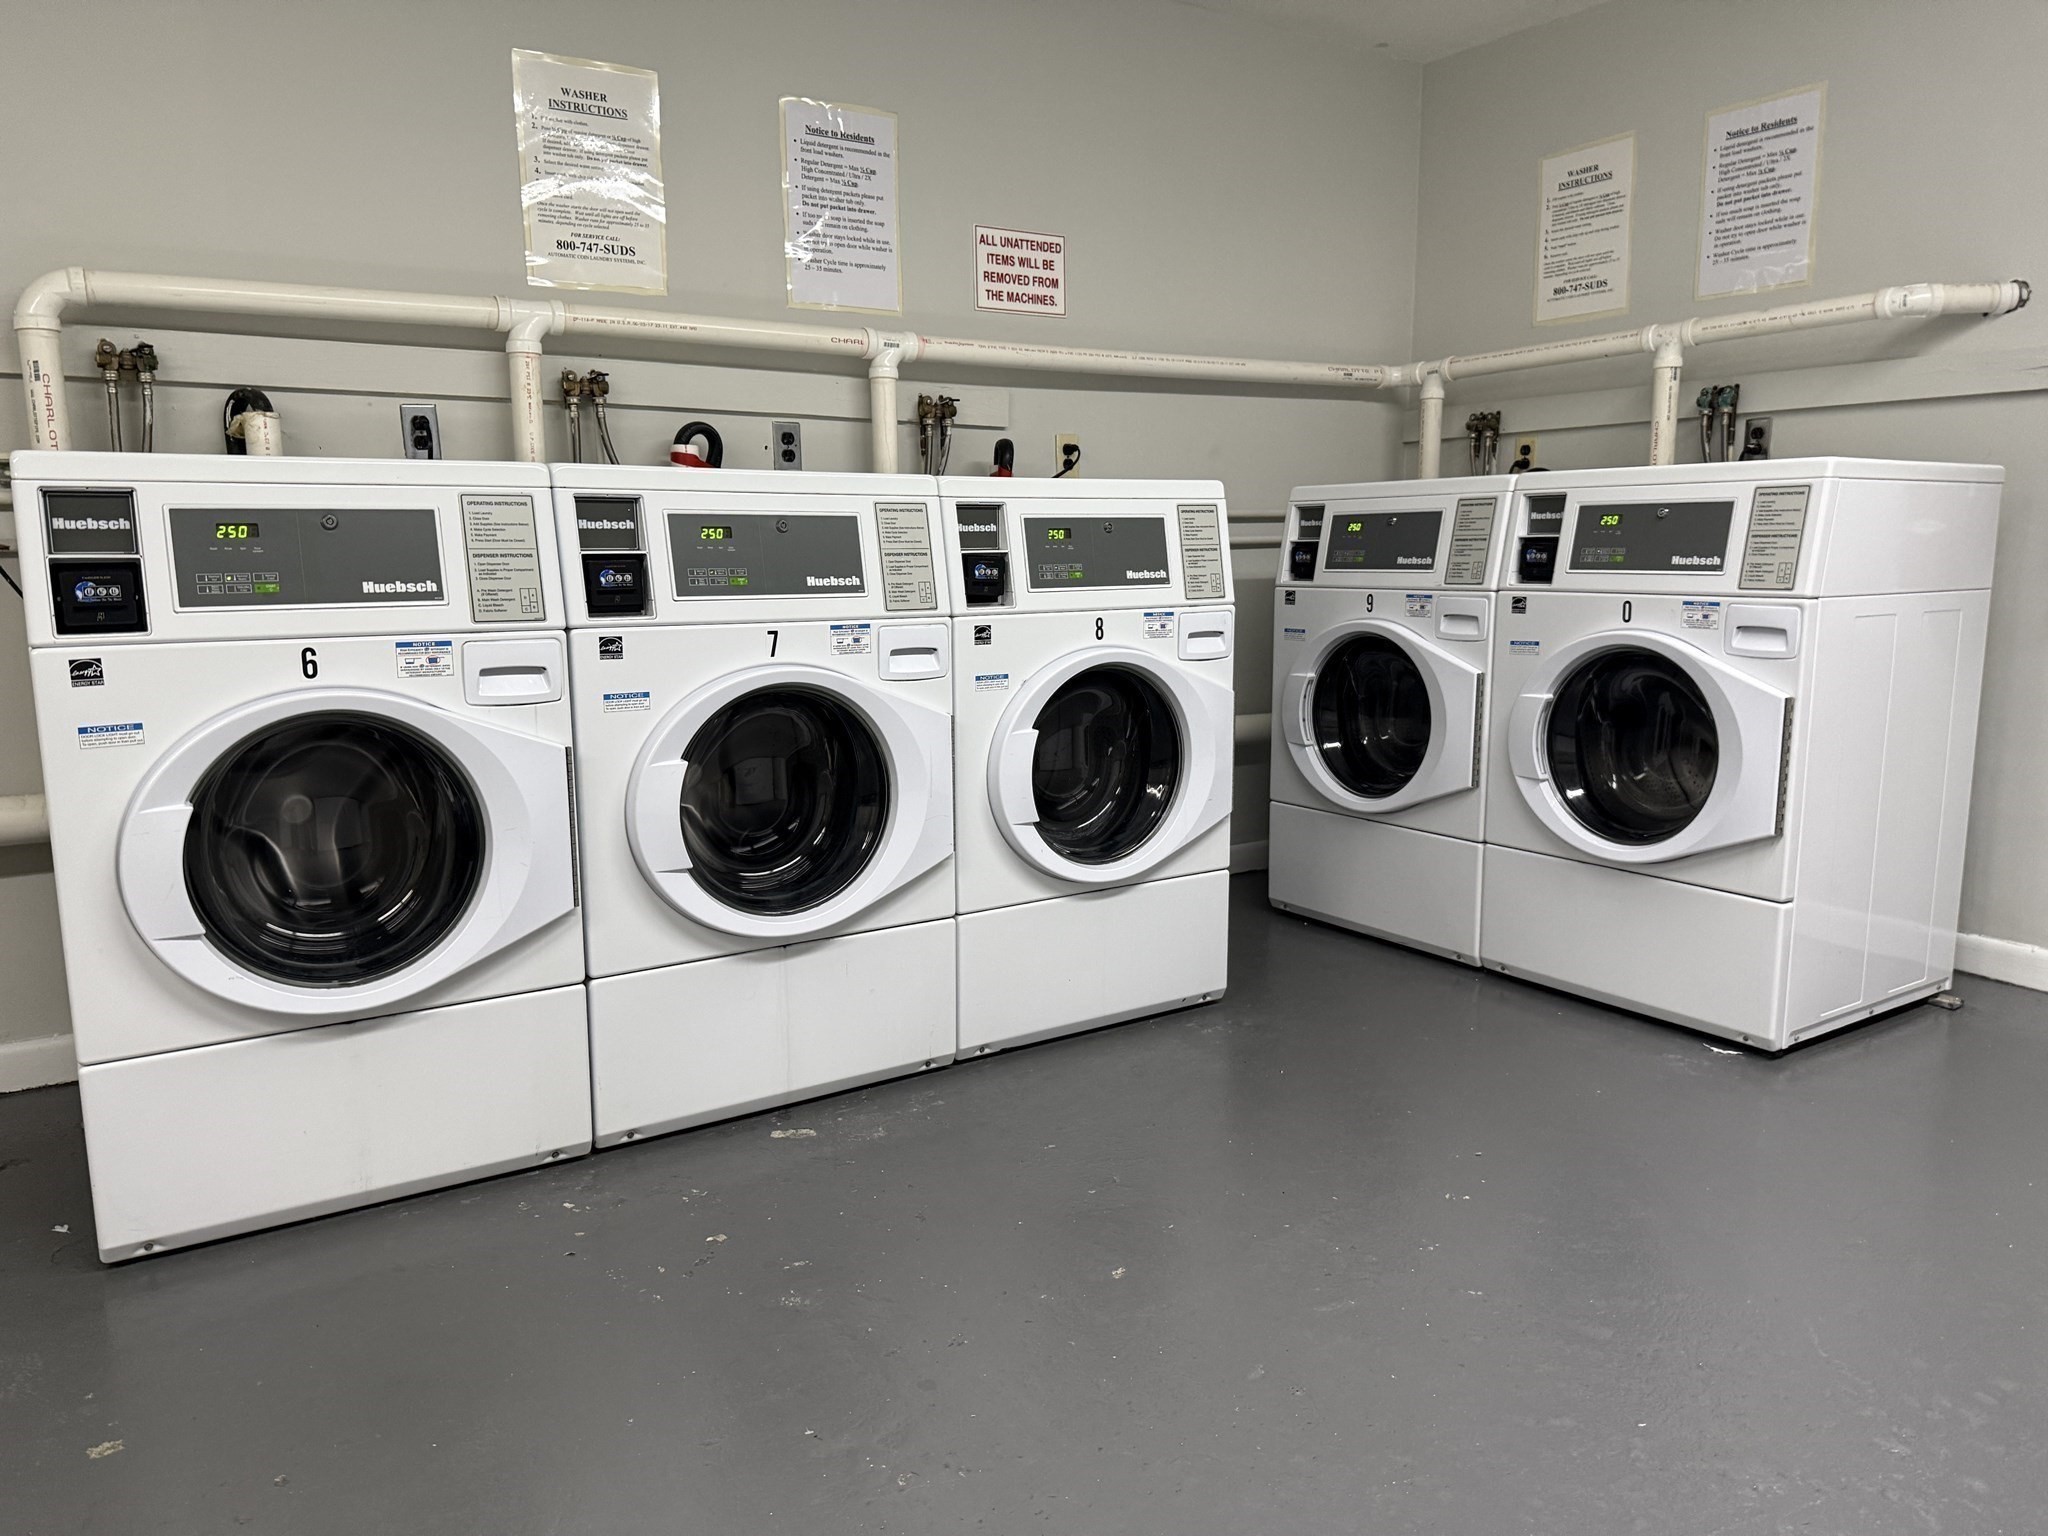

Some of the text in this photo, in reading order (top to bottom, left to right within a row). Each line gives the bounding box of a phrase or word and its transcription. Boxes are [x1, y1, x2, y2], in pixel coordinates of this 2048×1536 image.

[561, 87, 607, 103] WASHER
[548, 98, 628, 120] INSTRUCTIONS
[1725, 113, 1798, 141] Notice to Residents
[805, 124, 875, 145] Notice to Residents
[800, 138, 816, 148] Liquid
[817, 141, 839, 151] detergent
[845, 145, 876, 156] recommended
[533, 155, 540, 163] 3.
[801, 157, 819, 167] Regular
[821, 160, 843, 170] Detergent
[801, 165, 813, 173] High
[814, 167, 845, 178] Concentrated
[1567, 164, 1599, 178] WASHER
[801, 174, 824, 183] Detergent
[1558, 171, 1612, 190] INSTRUCTIONS
[802, 193, 817, 201] packet
[821, 187, 842, 196] detergent
[843, 190, 860, 199] packets
[861, 193, 875, 201] please
[830, 204, 846, 212] packet
[848, 217, 865, 225] inserted
[556, 239, 636, 256] 800-747-SUDS
[979, 234, 1061, 253] ALL UNATTENDED
[823, 259, 837, 267] Cycle
[855, 261, 887, 272] approximately
[987, 253, 1054, 270] ITEMS WILL BE
[984, 271, 1059, 289] REMOVED FROM
[1553, 279, 1608, 296] 800-747-SUDS
[985, 289, 1057, 306] THE MACHINES.
[52, 518, 131, 529] Huebsch
[578, 519, 634, 529] Huebsch
[1600, 516, 1618, 525] 250
[216, 525, 247, 538] 250
[701, 528, 723, 539] 250
[959, 524, 996, 532] Huebsch
[1348, 523, 1362, 532] 250
[1049, 530, 1064, 539] 250
[1397, 556, 1432, 564] Huebsch
[1671, 556, 1720, 566] Huebsch
[807, 576, 860, 586] Huebsch
[1126, 570, 1166, 579] Huebsch
[362, 581, 437, 594] Huebsch
[1366, 594, 1374, 613] 9
[1622, 601, 1632, 623] 0
[1095, 617, 1104, 640] 8
[767, 630, 778, 657] 7
[301, 647, 318, 679] 6
[88, 724, 134, 733] NOTICE
